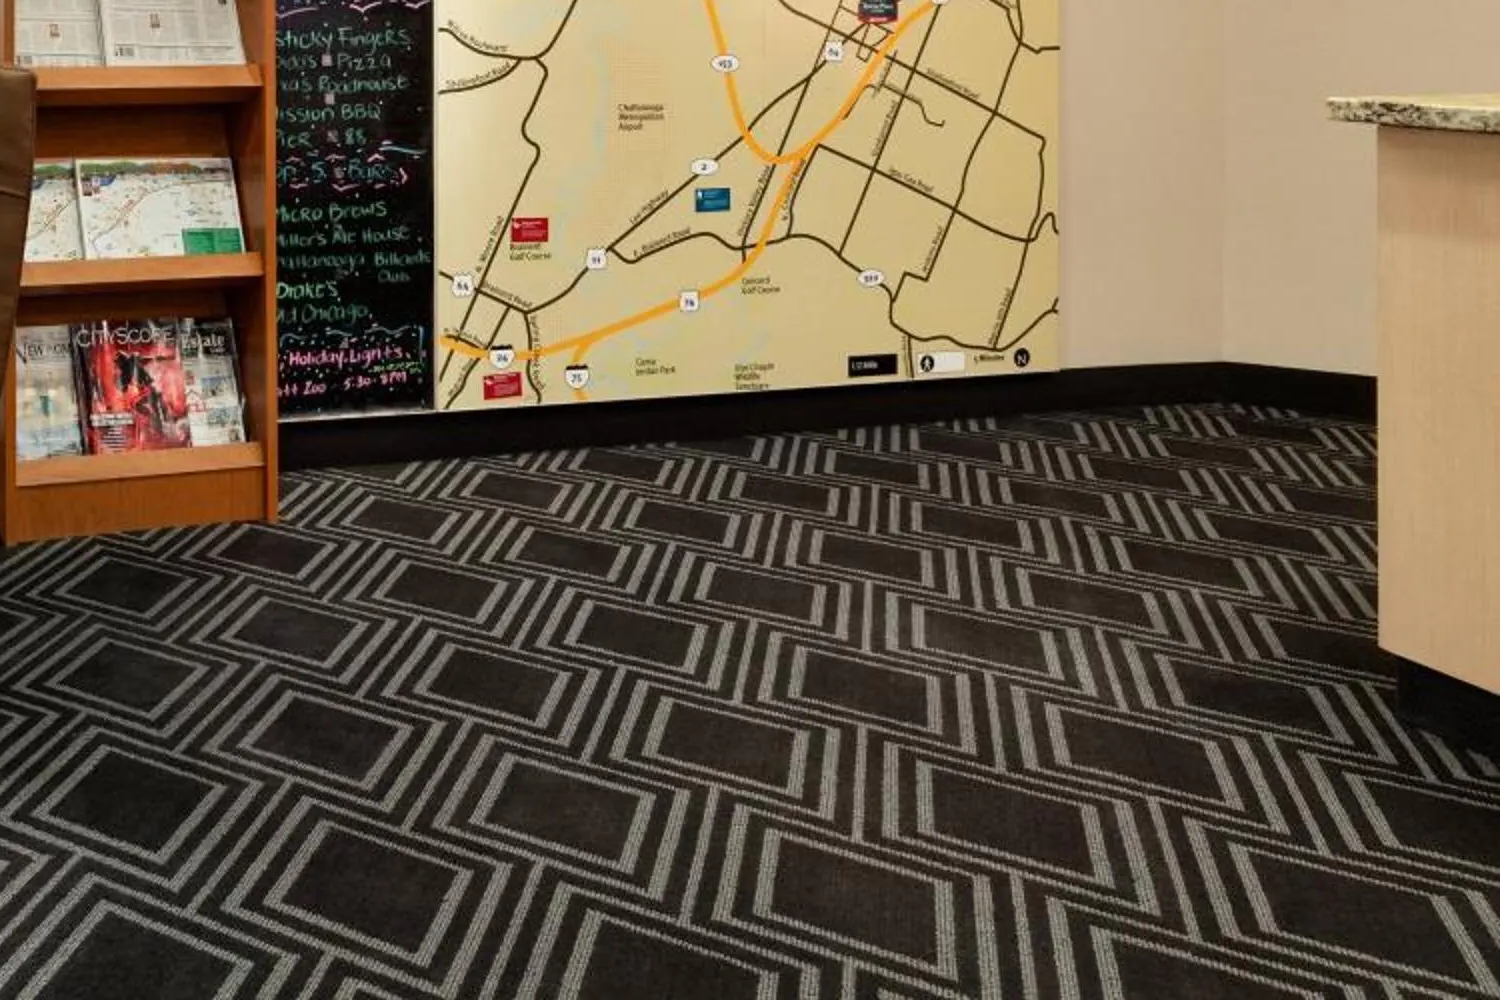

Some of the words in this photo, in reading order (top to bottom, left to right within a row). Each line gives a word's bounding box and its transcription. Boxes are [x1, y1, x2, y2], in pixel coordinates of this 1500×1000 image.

[276, 105, 335, 123] ission
[341, 103, 382, 121] BBQ
[277, 232, 327, 247] iller's
[289, 350, 344, 370] Holiday
